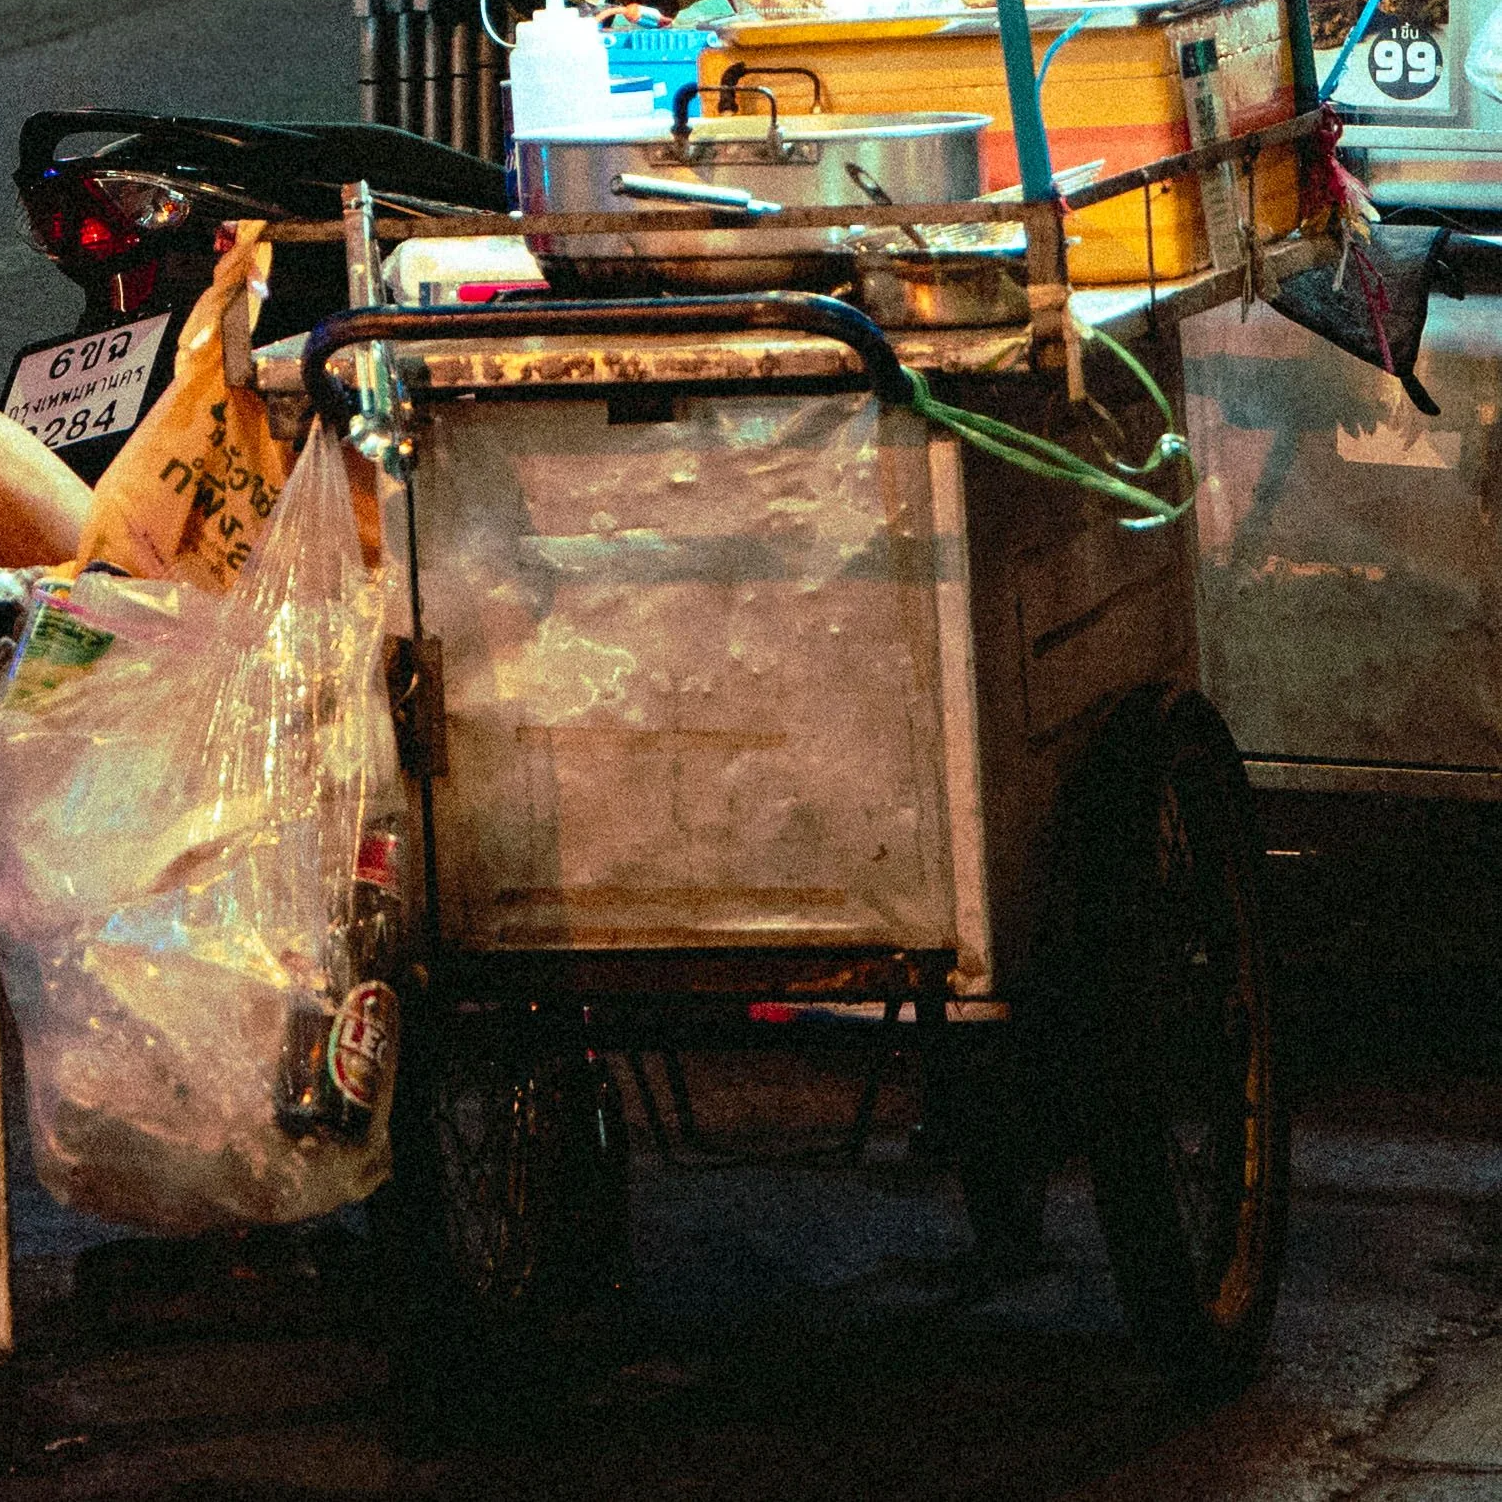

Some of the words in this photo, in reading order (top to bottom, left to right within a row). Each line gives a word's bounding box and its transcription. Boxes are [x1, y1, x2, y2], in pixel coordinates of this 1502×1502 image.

[1373, 40, 1436, 84] 99
[49, 330, 133, 380] 6ขฉ
[8, 365, 147, 425] กรุงเทพมหานคร
